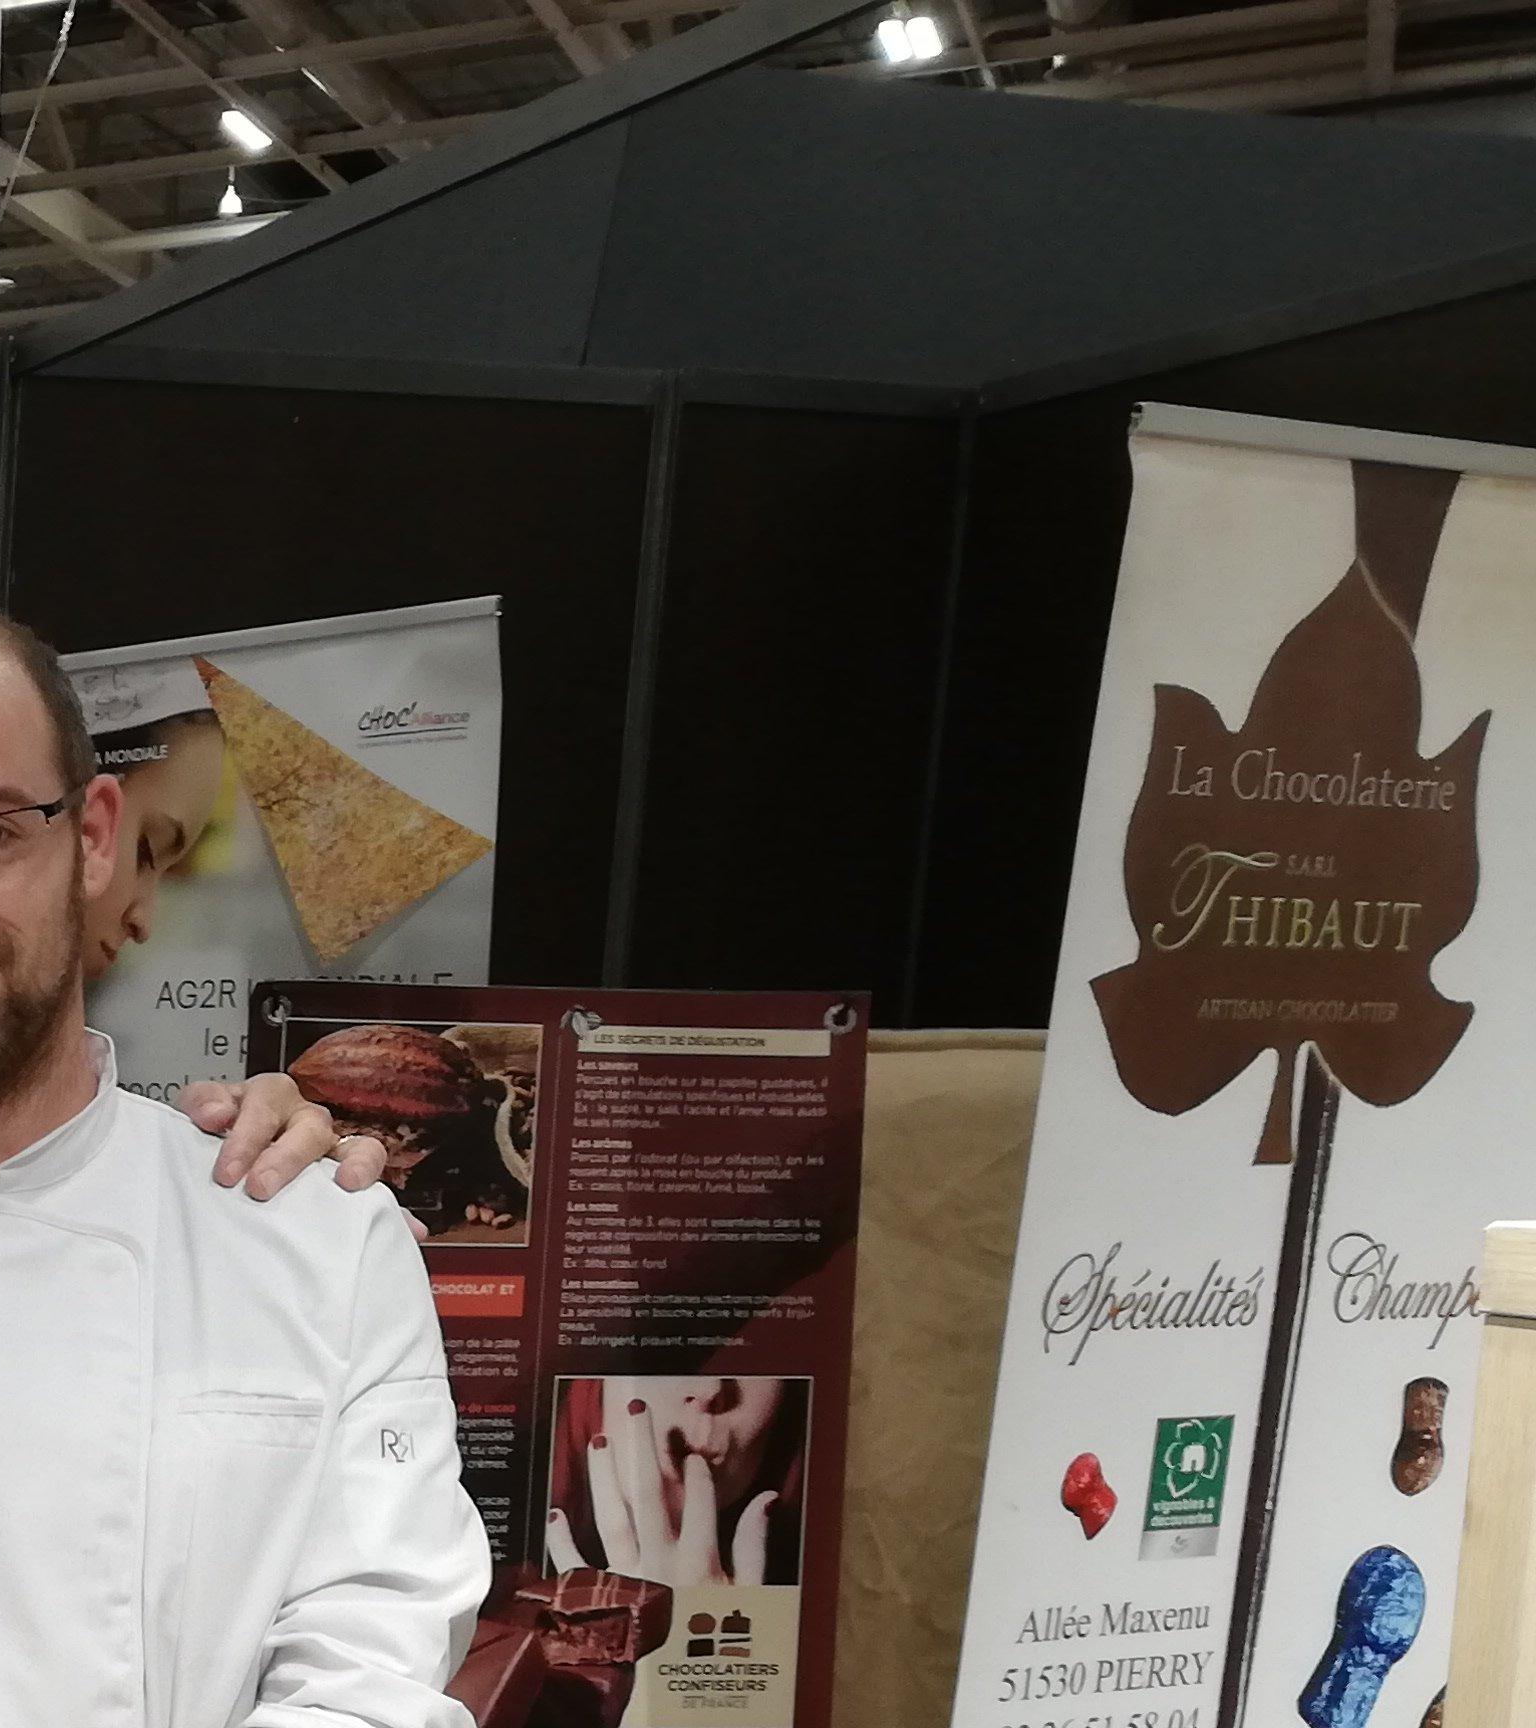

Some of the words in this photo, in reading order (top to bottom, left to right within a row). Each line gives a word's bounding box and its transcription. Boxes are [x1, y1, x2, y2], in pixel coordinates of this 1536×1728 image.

[1168, 745, 1214, 796] La
[1231, 746, 1457, 812] Chocolaterie
[1153, 843, 1422, 952] THIBAUT
[155, 979, 237, 1010] AG2R
[1197, 998, 1273, 1023] ARTISAN
[1277, 1000, 1400, 1023] CHOCOLATIER
[204, 1027, 229, 1057] le
[1041, 1241, 1265, 1366] Spécialités
[1015, 1605, 1093, 1645] Allée
[1098, 1602, 1211, 1640] Maxenu
[658, 1664, 780, 1676] CHOCOLATIERS
[668, 1680, 768, 1692] CONFISEURS
[997, 1660, 1087, 1703] 51530
[1093, 1651, 1215, 1695] PIERRY
